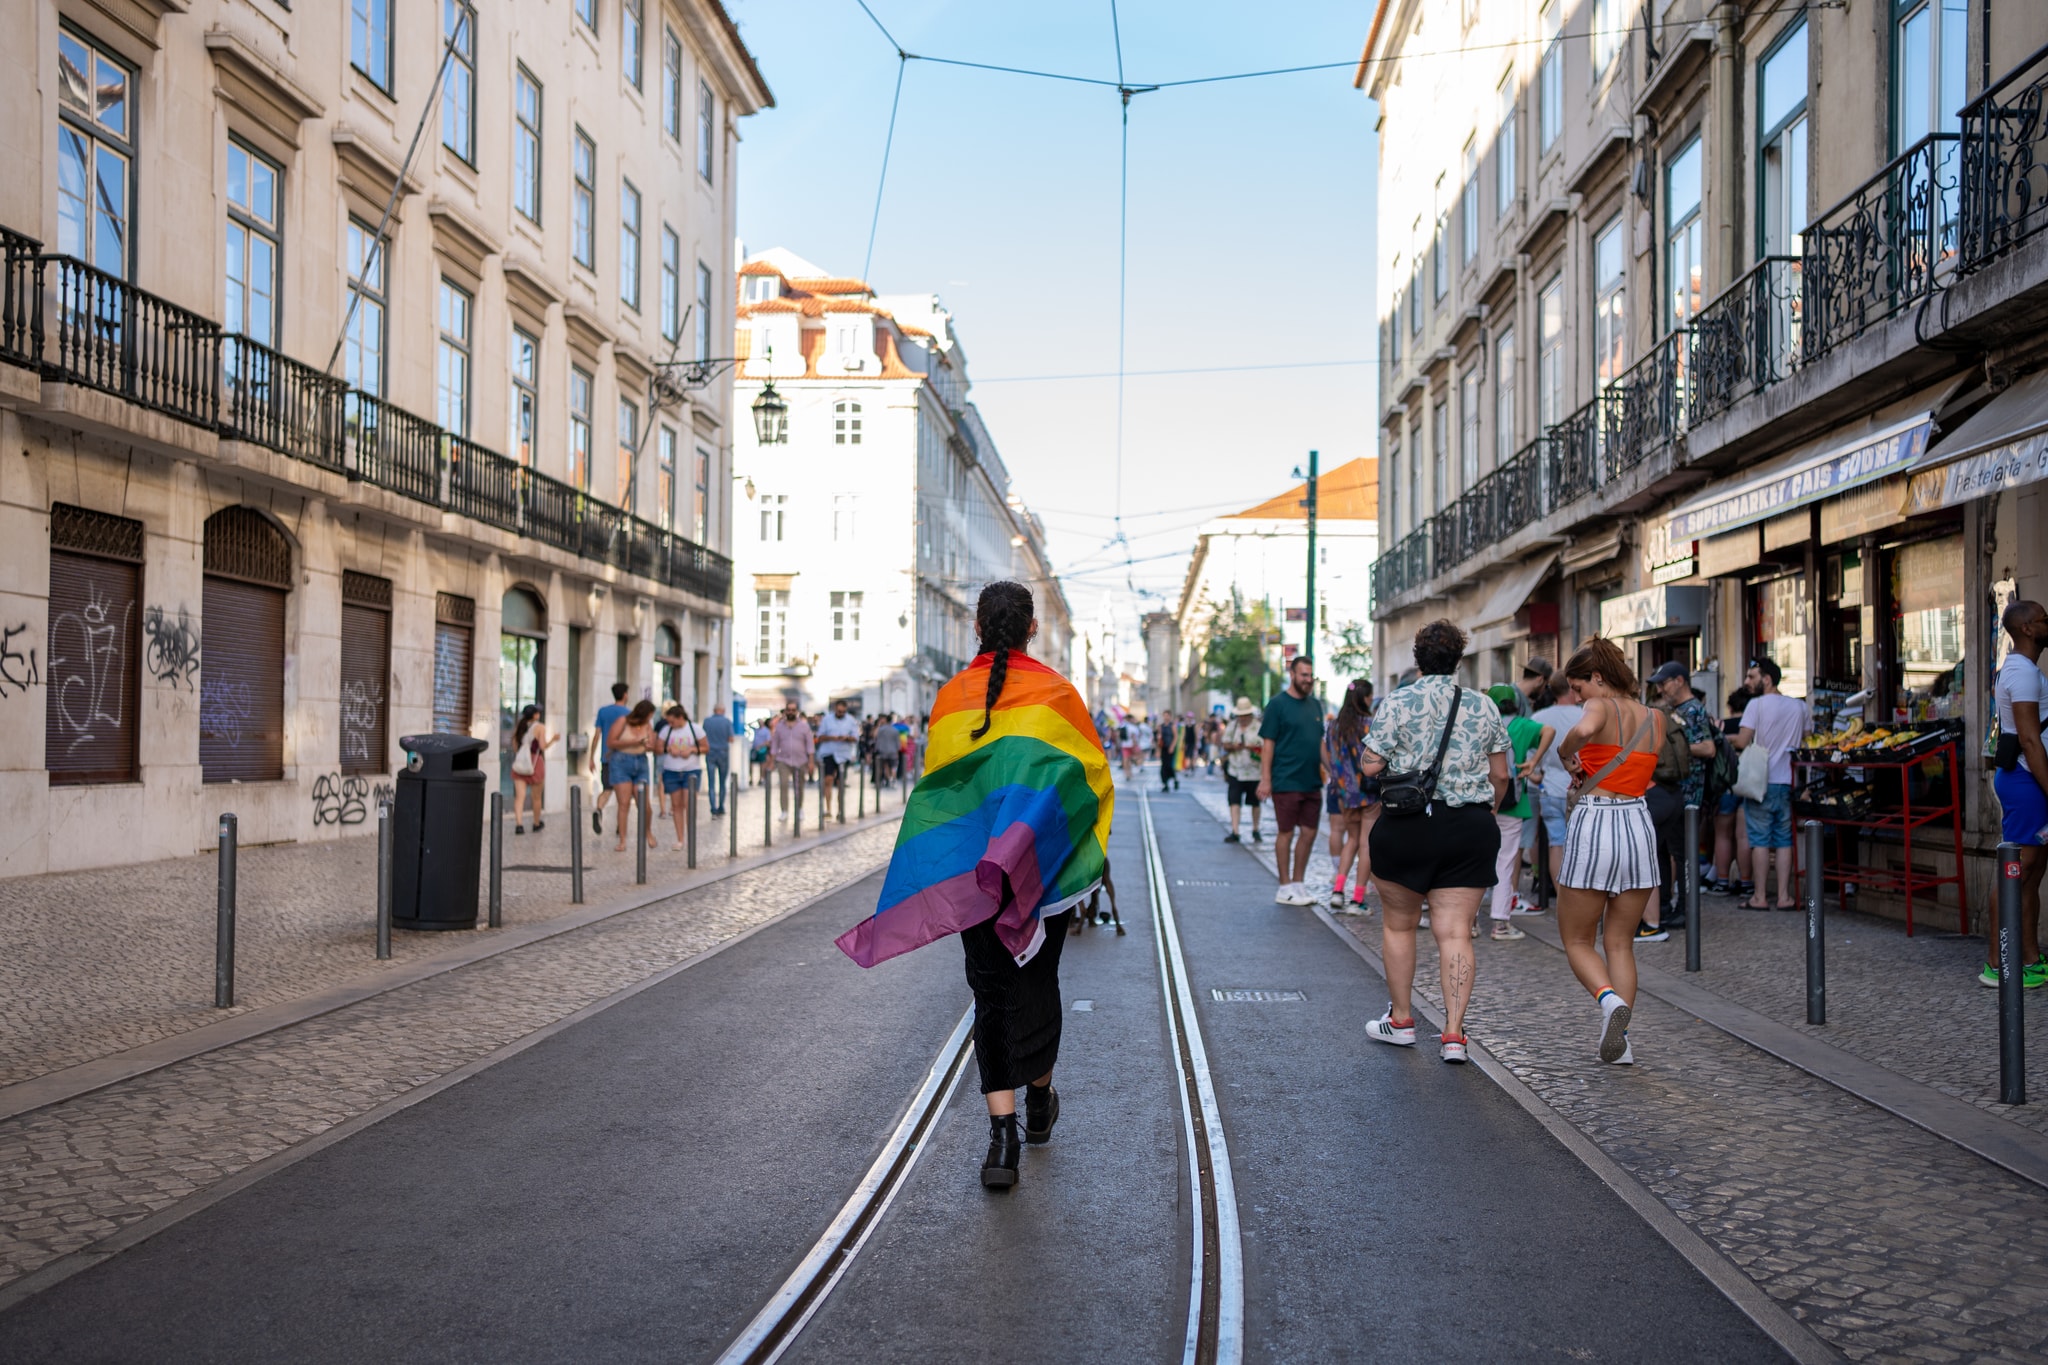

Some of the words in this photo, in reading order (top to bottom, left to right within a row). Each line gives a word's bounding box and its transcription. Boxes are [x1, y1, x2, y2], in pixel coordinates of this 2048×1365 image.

[1688, 483, 1786, 532] SUPERMARKET
[1791, 463, 1832, 497] CAIS
[1954, 459, 2021, 494] Pastelaria
